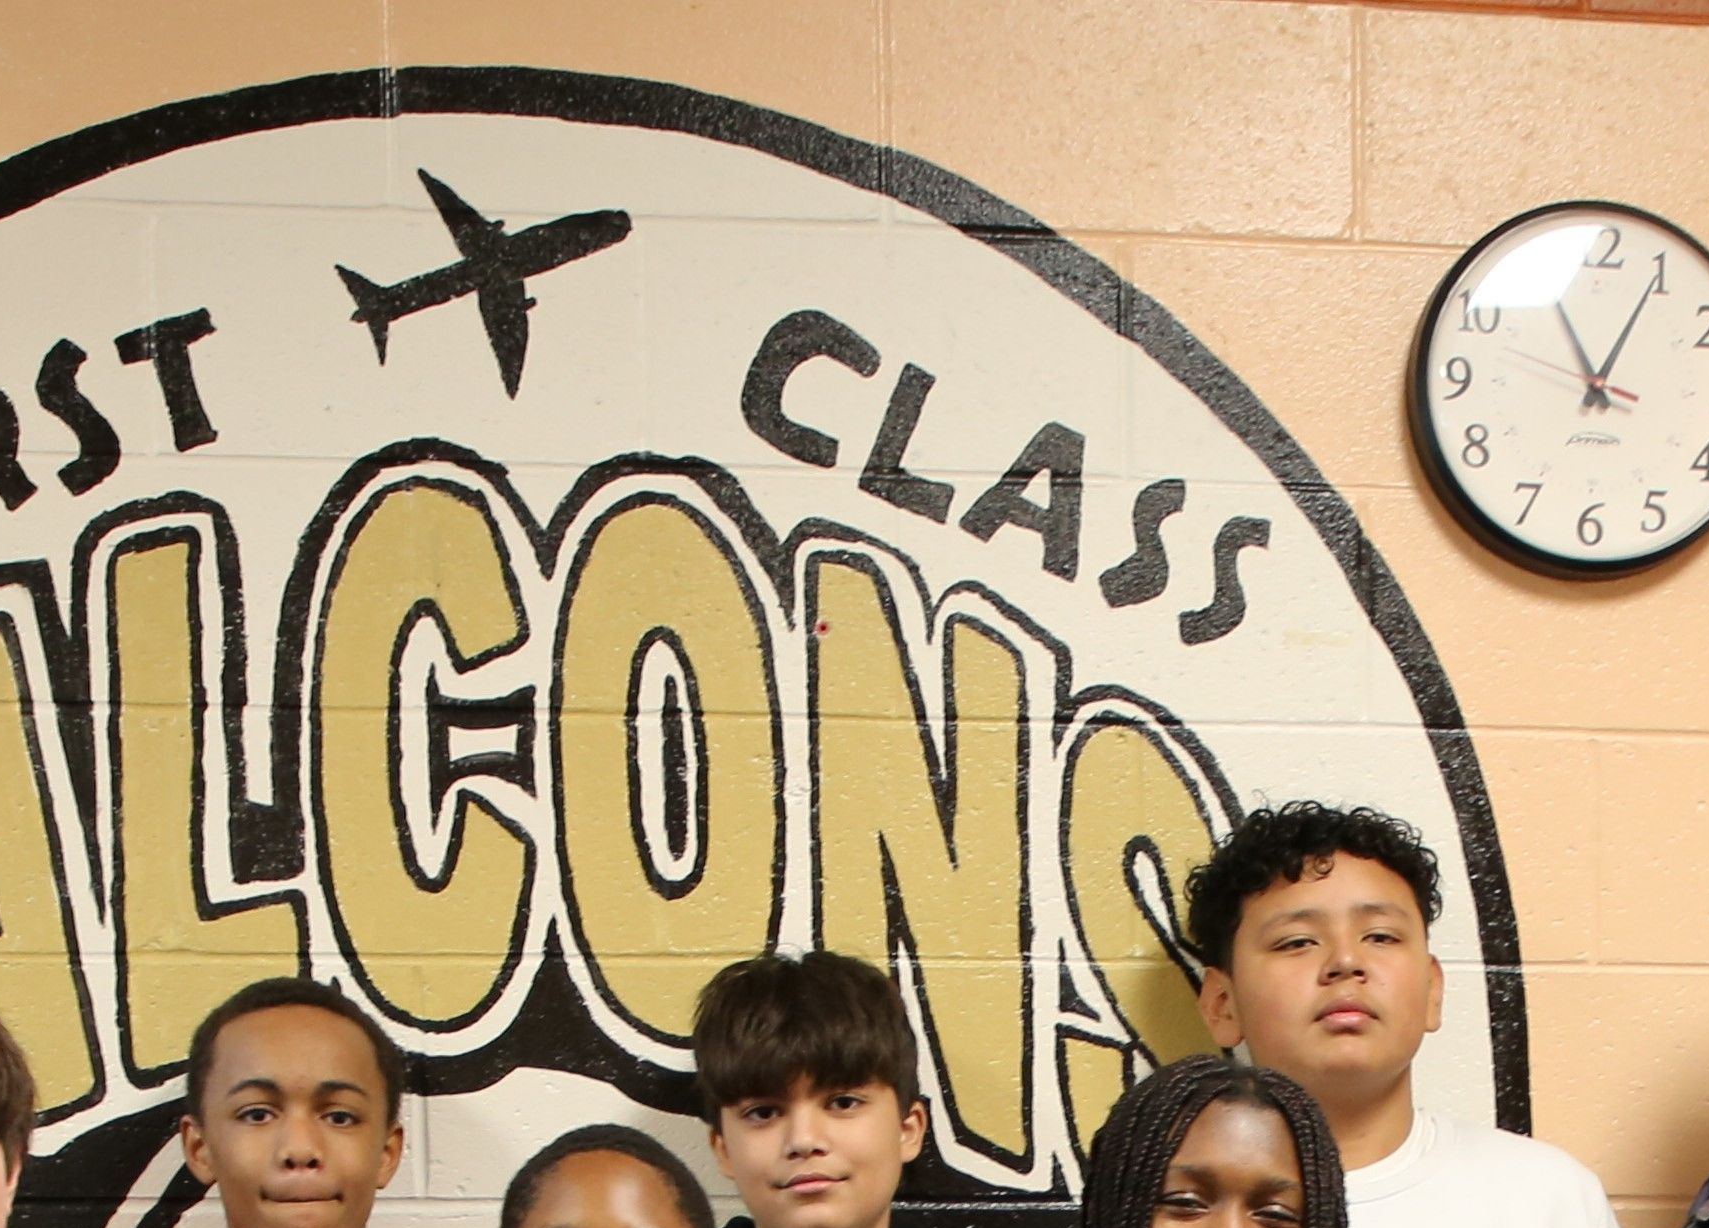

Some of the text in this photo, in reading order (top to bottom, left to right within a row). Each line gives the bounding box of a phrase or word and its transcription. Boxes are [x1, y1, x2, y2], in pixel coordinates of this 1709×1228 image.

[1652, 251, 1670, 295] 1
[1443, 357, 1473, 400] 9
[1461, 424, 1490, 468] 8
[740, 309, 1271, 645] CLASS
[1513, 482, 1544, 526] 7
[1577, 503, 1606, 546] 6
[1640, 490, 1669, 532] 5
